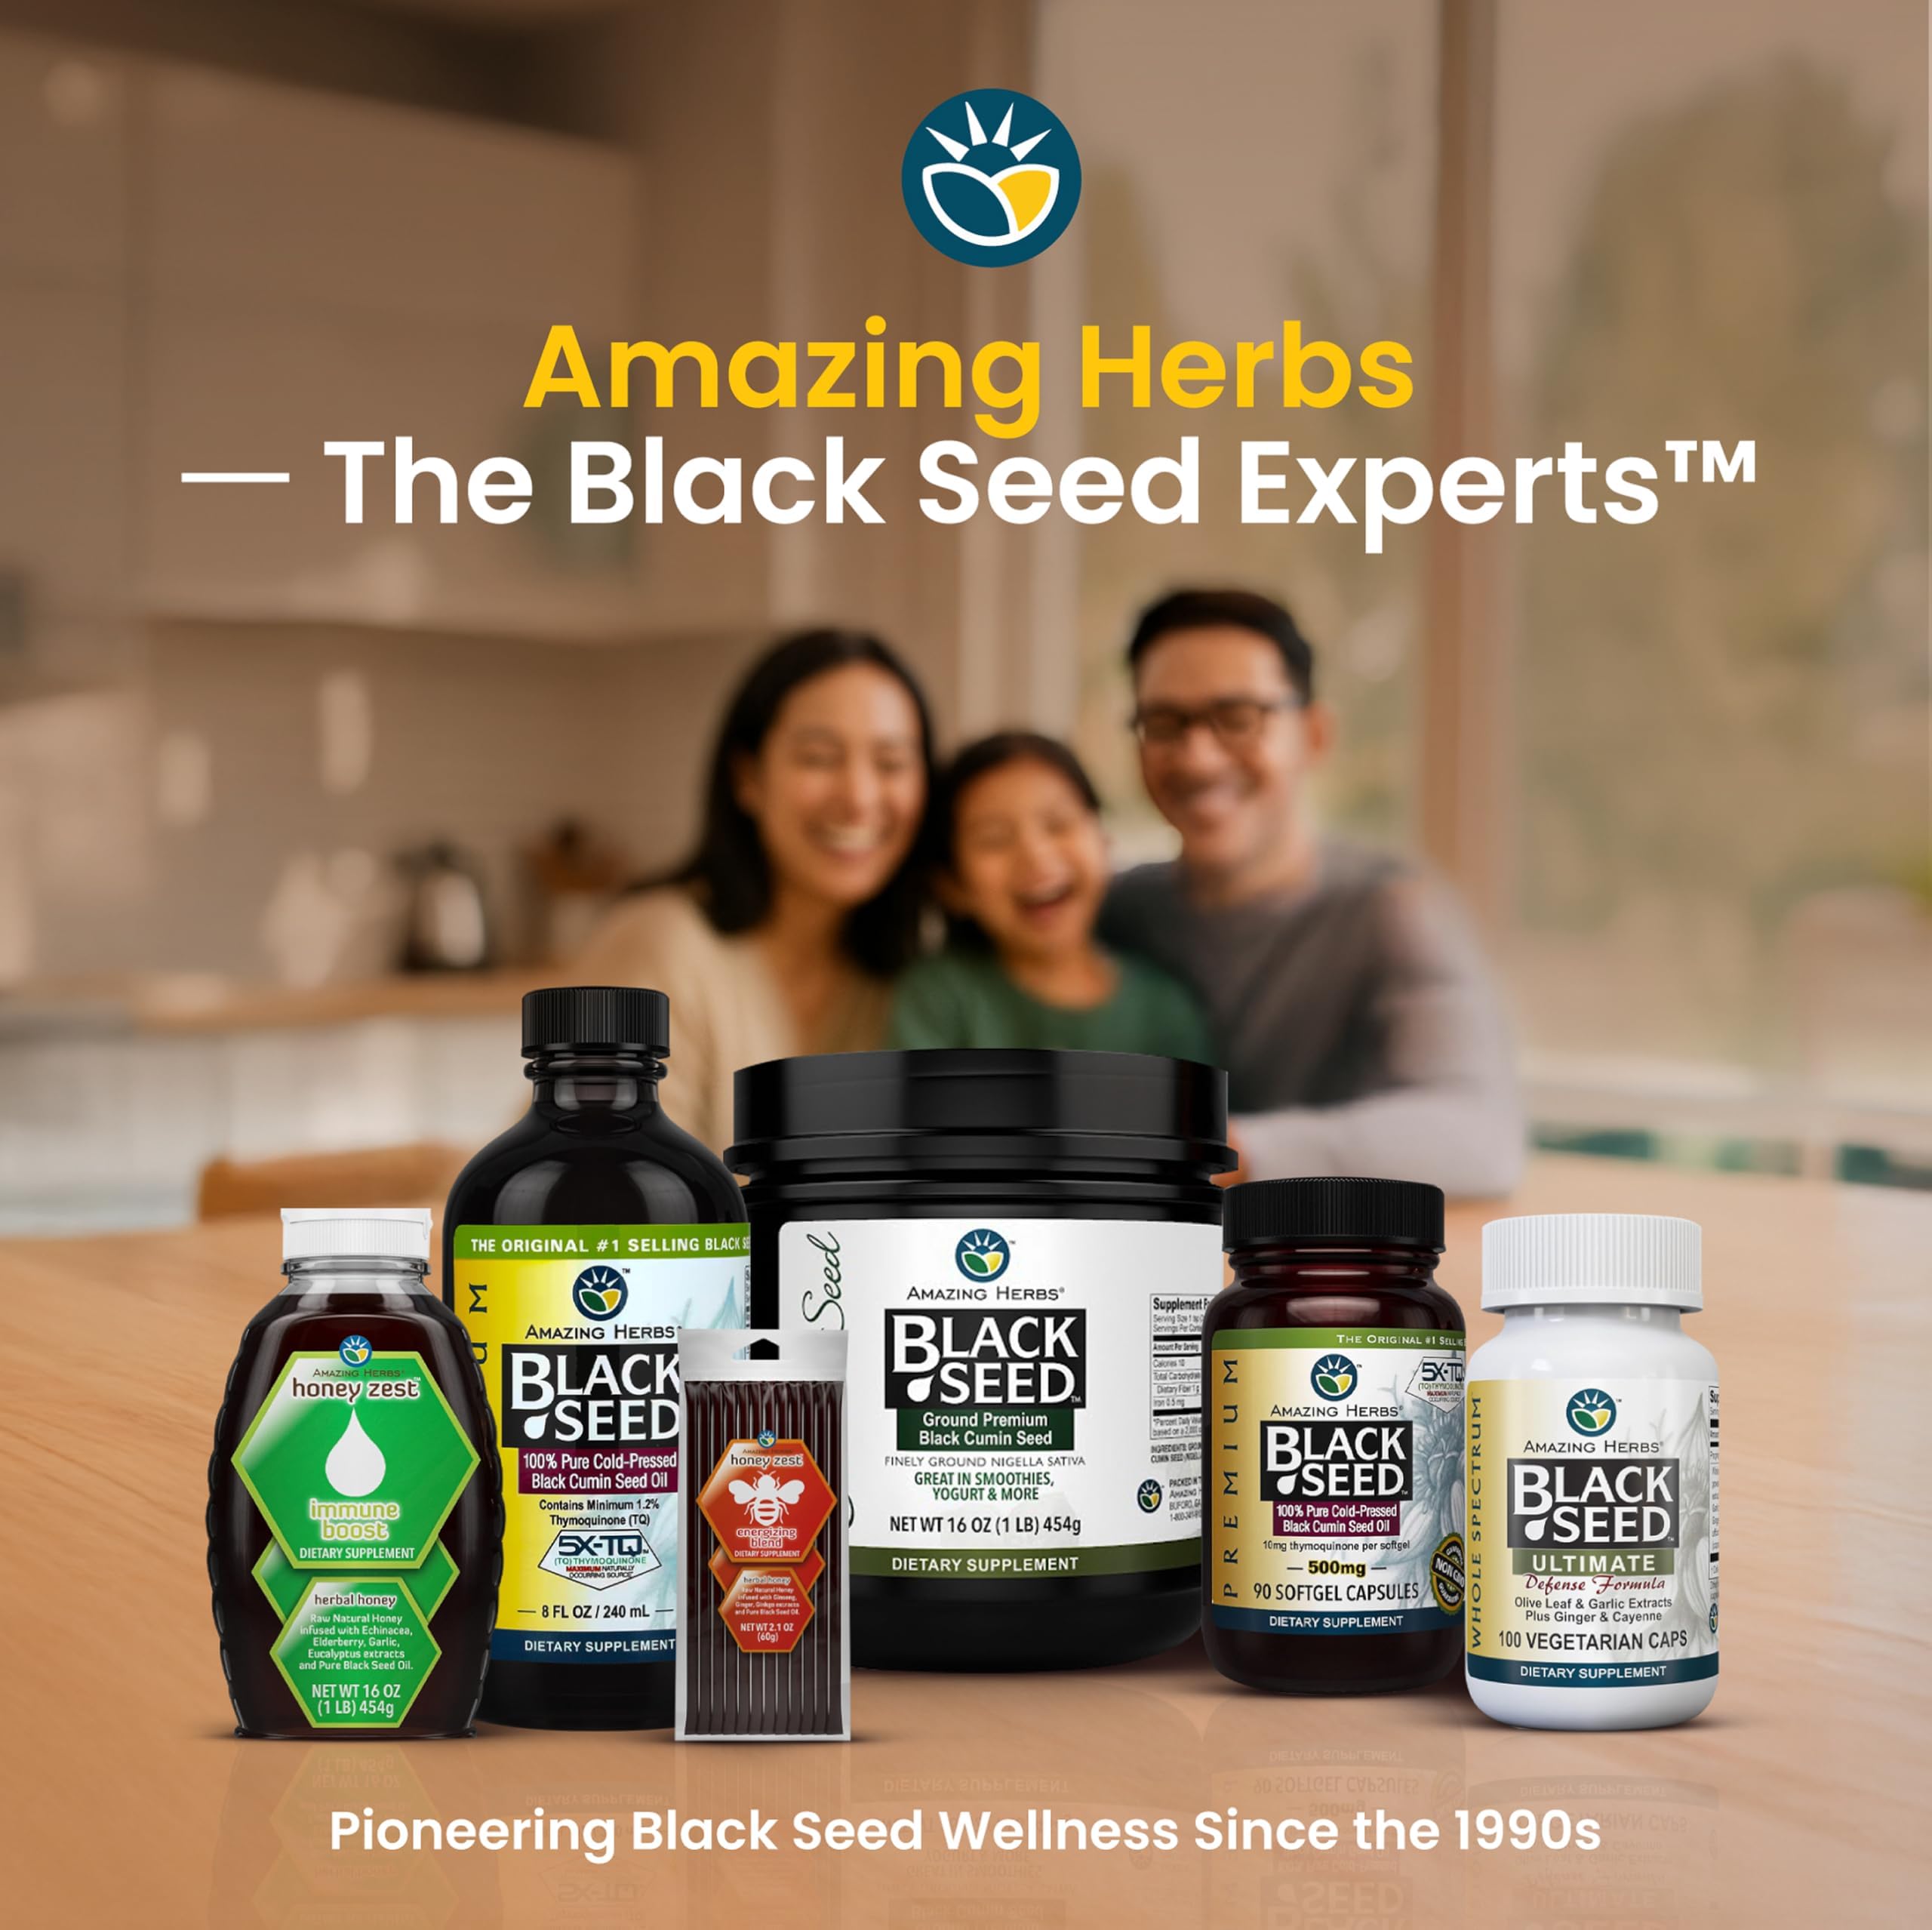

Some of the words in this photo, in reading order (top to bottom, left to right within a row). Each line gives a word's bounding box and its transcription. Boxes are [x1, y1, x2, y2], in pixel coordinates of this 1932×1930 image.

[471, 1239, 497, 1251] THE
[502, 1239, 589, 1253] ORIGINAL
[596, 1239, 620, 1252] #1
[628, 1237, 700, 1252] SELLING
[705, 1236, 740, 1251] BLACK
[906, 1286, 988, 1301] AMAZING
[1153, 1297, 1202, 1313] Supplement
[525, 1324, 605, 1340] AMAZING
[1337, 1334, 1362, 1344] THE
[1367, 1334, 1422, 1344] ORIGINAL
[891, 1315, 1079, 1373] BLACK
[312, 1368, 359, 1377] AMAZING
[511, 1352, 679, 1410] BLACK
[293, 1377, 361, 1403] honey
[1270, 1403, 1338, 1417] AMAZING
[555, 1399, 679, 1442] SEED
[923, 1412, 978, 1429] Ground
[983, 1413, 1048, 1428] Premium
[919, 1431, 961, 1446] Black
[964, 1431, 1013, 1446] Cumin
[1016, 1431, 1053, 1446] Seed
[1266, 1426, 1407, 1472] BLACK
[1523, 1439, 1596, 1454] AMAZING
[523, 1454, 557, 1470] 100%
[561, 1454, 589, 1470] Pure
[593, 1451, 677, 1469] Cold-Pressed
[730, 1454, 771, 1470] honey
[884, 1457, 926, 1467] FINELY
[929, 1457, 989, 1467] GROUND
[992, 1457, 1043, 1467] NIGELLA
[1046, 1457, 1086, 1467] SATIVA
[1472, 1396, 1481, 1541] SPECTRUM
[531, 1474, 566, 1490] Black
[569, 1473, 612, 1489] Cumin
[615, 1473, 650, 1489] Seed
[653, 1473, 668, 1488] Oil
[915, 1472, 954, 1486] GREAT
[957, 1472, 971, 1485] IN
[974, 1472, 1054, 1488] SMOOTHIES,
[1223, 1359, 1238, 1599] PREMIUM
[932, 1488, 984, 1501] YOGURT
[1001, 1488, 1039, 1501] MORE
[1513, 1464, 1674, 1516] BLACK
[309, 1499, 399, 1521] immune
[539, 1499, 584, 1510] Contains
[587, 1499, 634, 1510] Minimum
[636, 1498, 660, 1510] 1.2%
[1276, 1504, 1304, 1518] 100%
[1306, 1505, 1328, 1517] Pure
[1331, 1504, 1397, 1518] Cold-Pressed
[549, 1515, 626, 1528] Thymoquinone
[629, 1514, 651, 1527] (TQ)
[890, 1517, 917, 1533] NET
[920, 1517, 943, 1533] WT
[947, 1517, 967, 1533] 16
[971, 1517, 992, 1534] OZ
[1016, 1516, 1040, 1535] LB)
[1043, 1516, 1081, 1536] 454g
[1283, 1520, 1310, 1533] Black
[1312, 1520, 1346, 1533] Cumin
[1349, 1520, 1374, 1533] Seed
[1377, 1519, 1389, 1532] Oil
[321, 1519, 389, 1541] boost
[737, 1527, 797, 1541] energizing
[750, 1538, 783, 1548] blend
[1263, 1541, 1287, 1552] 10mg
[1290, 1541, 1360, 1552] thymoquinone
[1362, 1542, 1377, 1552] per
[1380, 1539, 1410, 1552] softgel
[300, 1547, 344, 1559] DIETARY
[346, 1547, 414, 1559] SUPPLEMENT
[891, 1557, 962, 1571] DIETARY
[967, 1556, 1079, 1571] SUPPLEMENT
[1308, 1561, 1367, 1577] 500mg
[1532, 1554, 1656, 1572] ULTIMATE
[1254, 1583, 1271, 1600] 90
[1275, 1584, 1343, 1602] SOFTGEL
[1346, 1582, 1419, 1602] CAPSULES
[1523, 1574, 1586, 1596] Defense
[1592, 1574, 1666, 1594] Formula
[314, 1593, 355, 1606] herbal
[356, 1593, 396, 1608] honey
[1472, 1554, 1481, 1648] WHOLE
[1515, 1596, 1543, 1608] Olive
[1546, 1596, 1573, 1608] Leaf
[1588, 1596, 1625, 1608] Garlic
[1629, 1596, 1672, 1608] Extracts
[542, 1605, 549, 1619] 8
[552, 1605, 570, 1618] FL
[573, 1605, 593, 1618] OZ
[603, 1605, 627, 1618] 240
[630, 1604, 650, 1618] mL
[1525, 1610, 1550, 1622] Plus
[1554, 1610, 1598, 1624] Ginger
[1612, 1610, 1663, 1624] Cayenne
[310, 1614, 331, 1624] Raw
[333, 1614, 370, 1624] Natural
[371, 1614, 403, 1626] Honey
[1269, 1615, 1319, 1628] DIETARY
[1323, 1615, 1404, 1628] SUPPLEMENT
[300, 1625, 337, 1636] infused
[339, 1625, 360, 1636] with
[362, 1625, 413, 1637] Echinacea,
[313, 1636, 366, 1648] Elderberry,
[525, 1639, 580, 1653] DIETARY
[585, 1638, 675, 1653] SUPPLEMENT
[1499, 1630, 1522, 1648] 100
[1527, 1631, 1643, 1651] VEGETARIAN
[1649, 1630, 1687, 1648] CAPS
[308, 1648, 361, 1661] Eucalyptus
[363, 1648, 405, 1659] extracts
[299, 1660, 317, 1670] and
[318, 1660, 342, 1670] Pure
[343, 1660, 369, 1670] Black
[371, 1660, 396, 1670] Seed
[1520, 1665, 1575, 1678] DIETARY
[1579, 1665, 1667, 1679] SUPPLEMENT
[312, 1684, 337, 1698] NET
[338, 1684, 361, 1698] WT
[362, 1684, 380, 1698] 16
[383, 1684, 401, 1698] OZ
[334, 1700, 357, 1717] LB)
[359, 1700, 395, 1717] 454g
